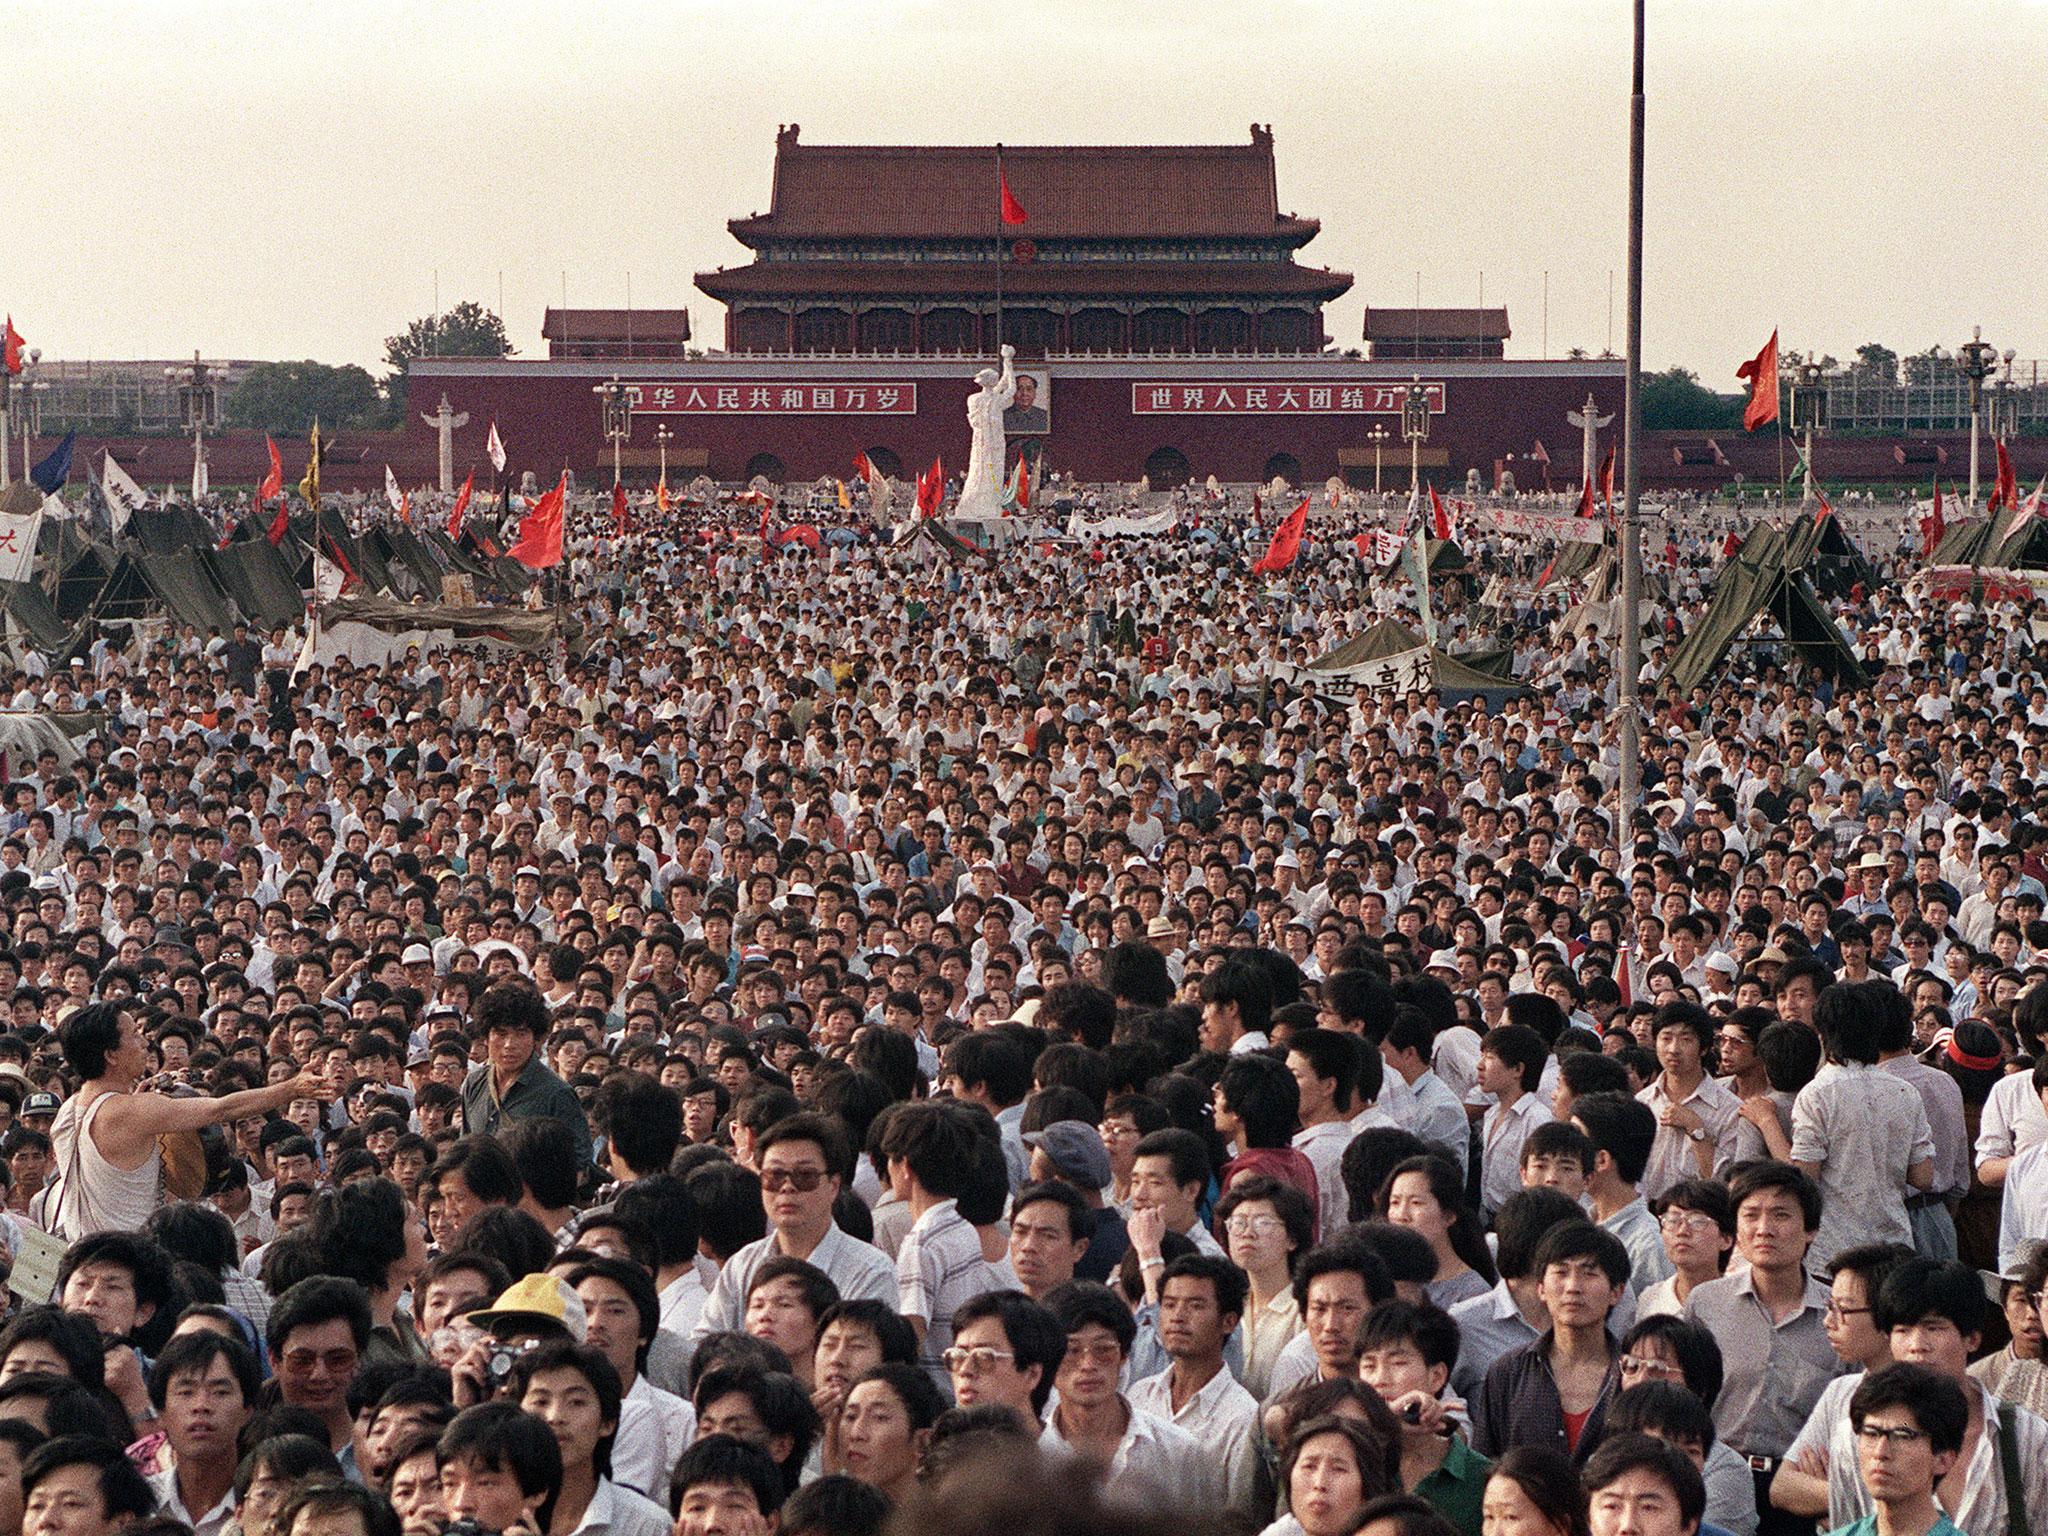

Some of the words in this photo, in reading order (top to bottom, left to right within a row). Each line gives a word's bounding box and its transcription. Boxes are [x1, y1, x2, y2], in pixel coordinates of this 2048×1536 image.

[627, 387, 900, 409] 中华人民共和国万岁
[1150, 387, 1428, 409] 世界人民大团结万
[1154, 643, 1163, 656] 9
